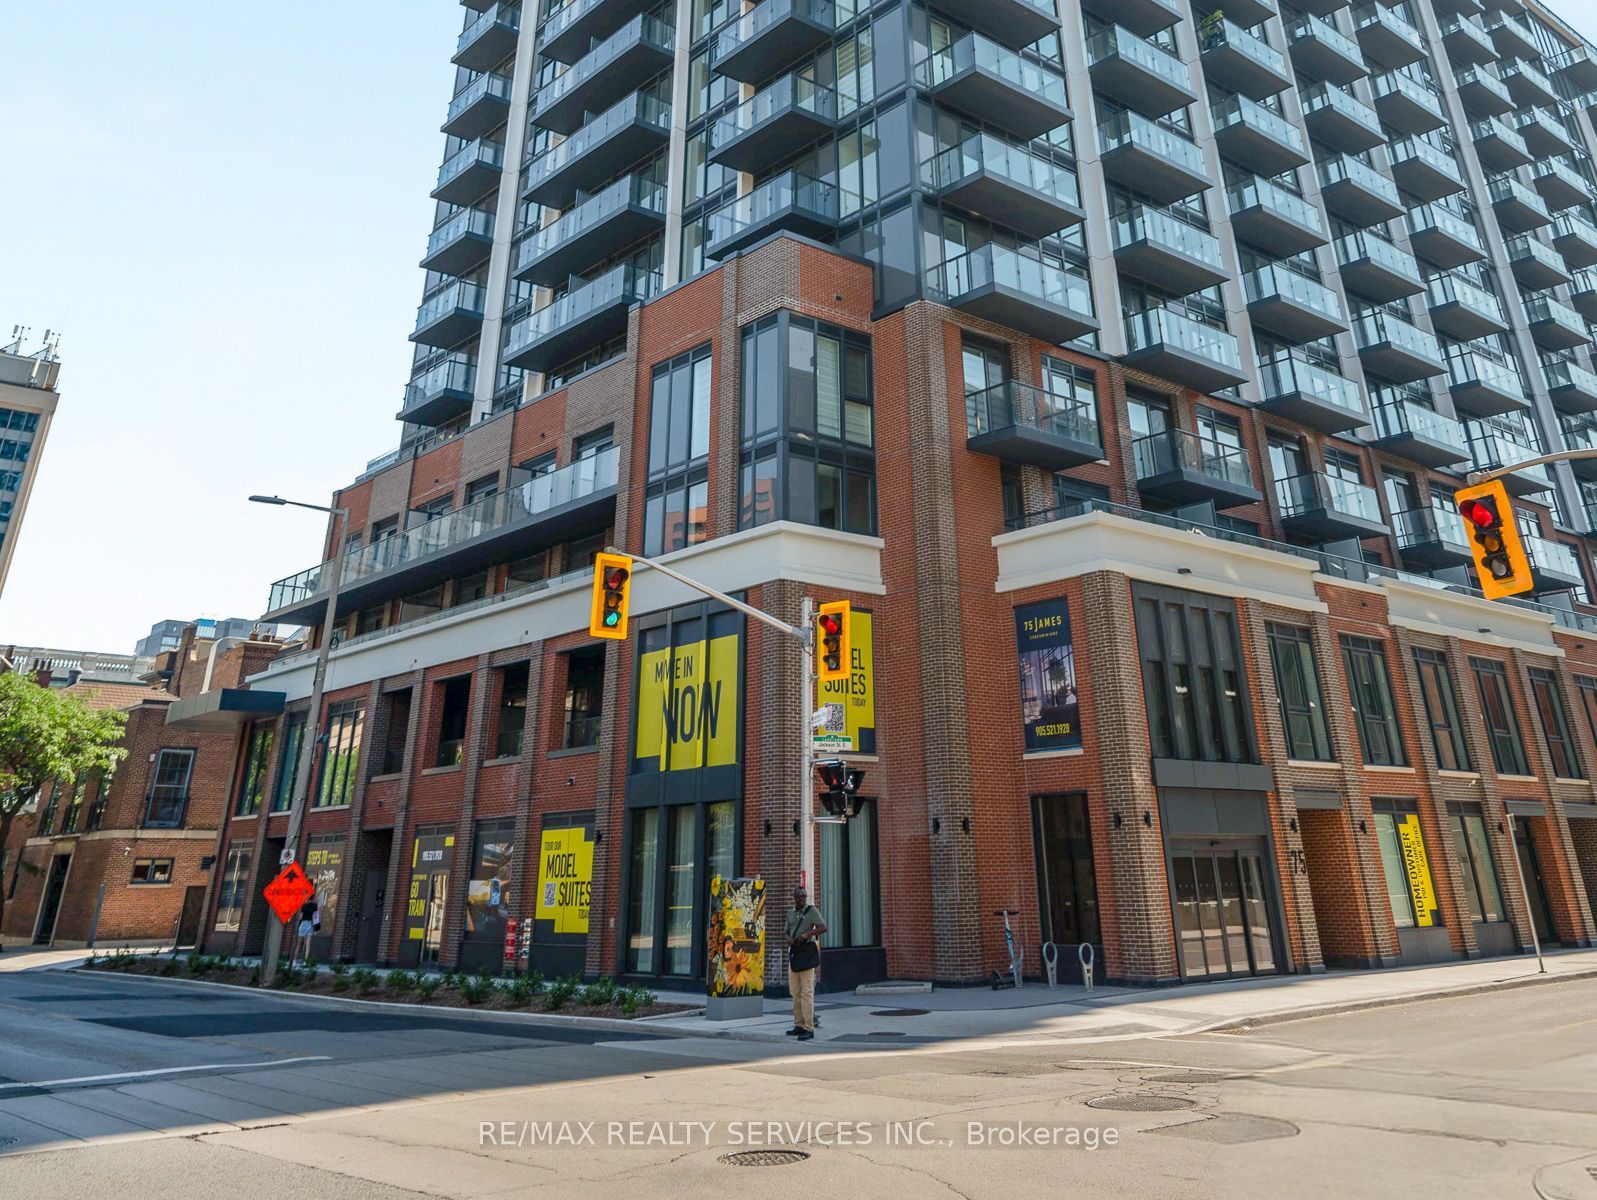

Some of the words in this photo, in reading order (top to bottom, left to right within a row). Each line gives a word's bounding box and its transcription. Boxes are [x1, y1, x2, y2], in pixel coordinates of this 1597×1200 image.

[1024, 620, 1033, 631] 75
[1034, 615, 1062, 632] JAMES
[684, 655, 693, 678] IN
[663, 680, 722, 744] NOW
[546, 853, 577, 878] MODEL
[1291, 850, 1307, 874] 75
[1402, 832, 1426, 918] HOMEOWNER
[558, 881, 591, 906] SUITES
[408, 899, 426, 916] TRAIN
